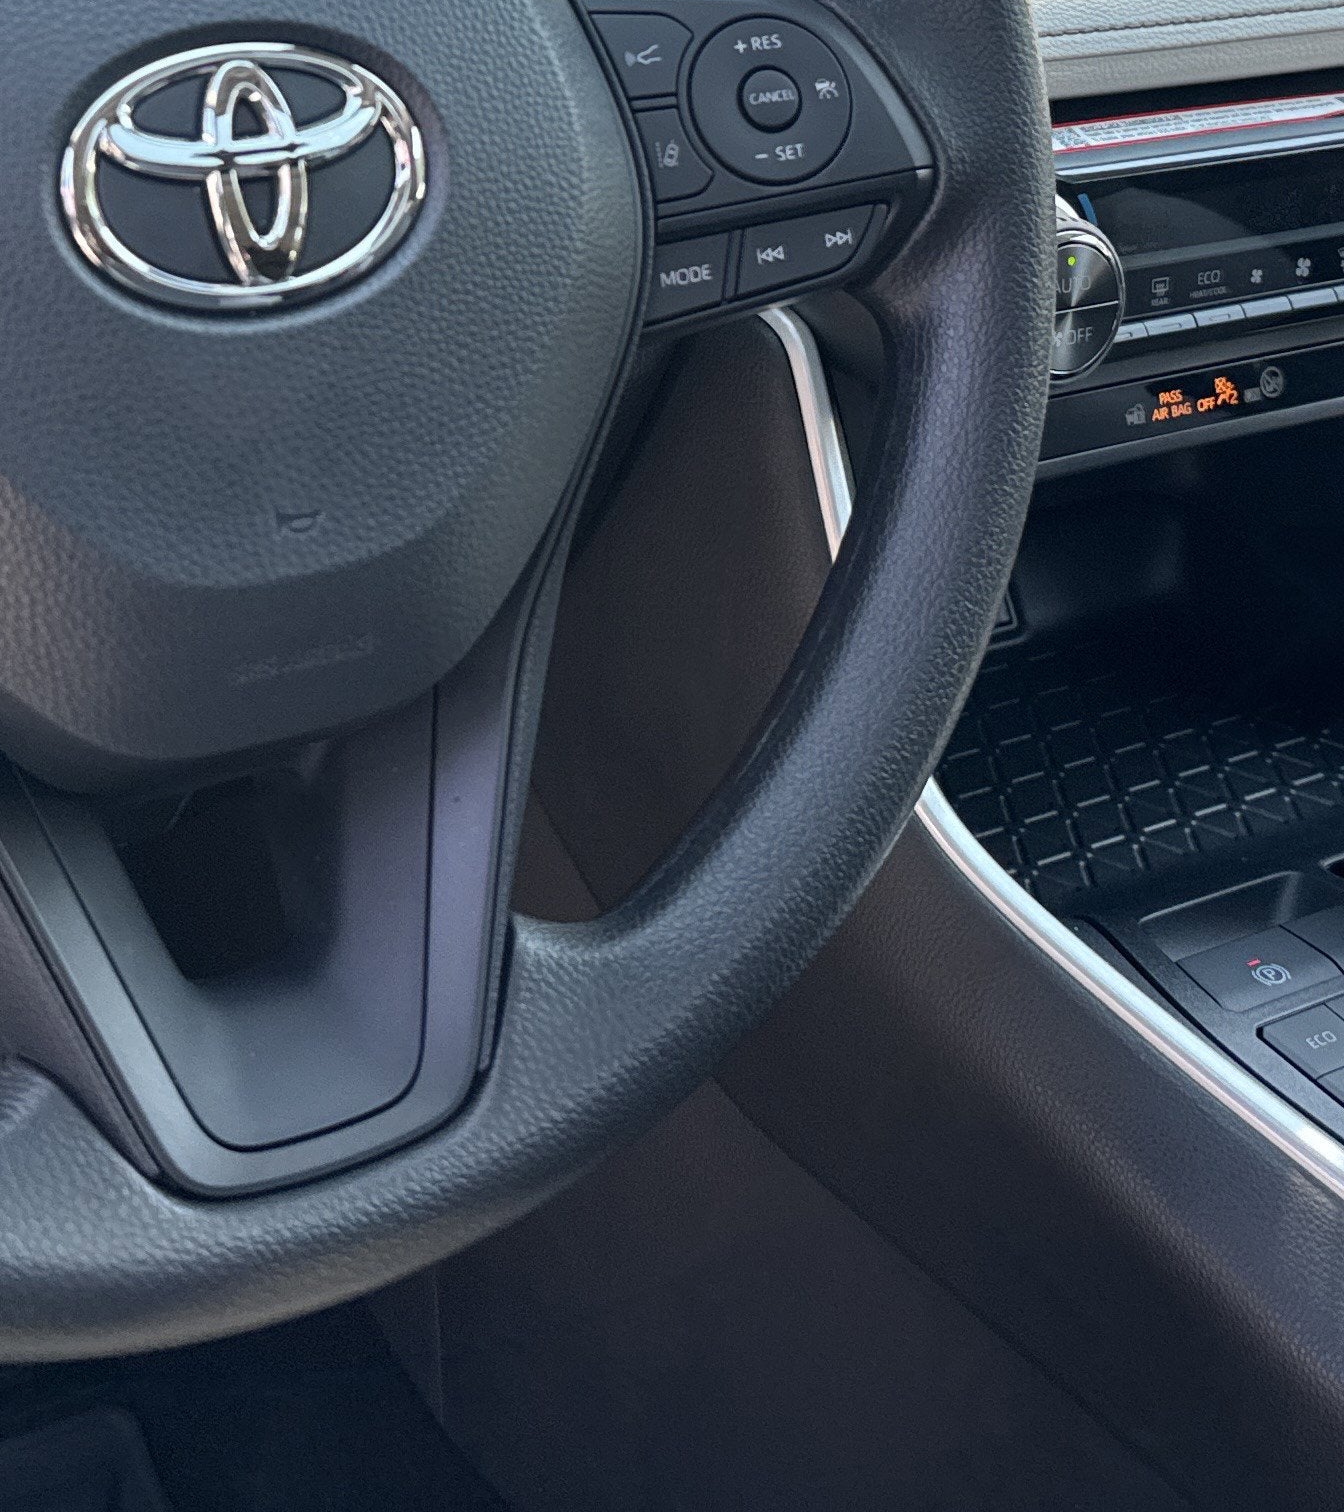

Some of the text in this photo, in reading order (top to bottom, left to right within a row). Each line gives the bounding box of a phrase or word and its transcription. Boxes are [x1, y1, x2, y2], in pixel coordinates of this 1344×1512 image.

[750, 34, 783, 51] RES
[749, 89, 796, 105] CANCEL
[775, 143, 805, 161] SET
[659, 263, 713, 288] MODE
[1197, 269, 1222, 286] ECO
[1066, 327, 1094, 345] OFF
[1158, 389, 1184, 405] PASS
[1152, 396, 1216, 422] AIR BAG OFF
[1305, 1030, 1338, 1050] ECO
